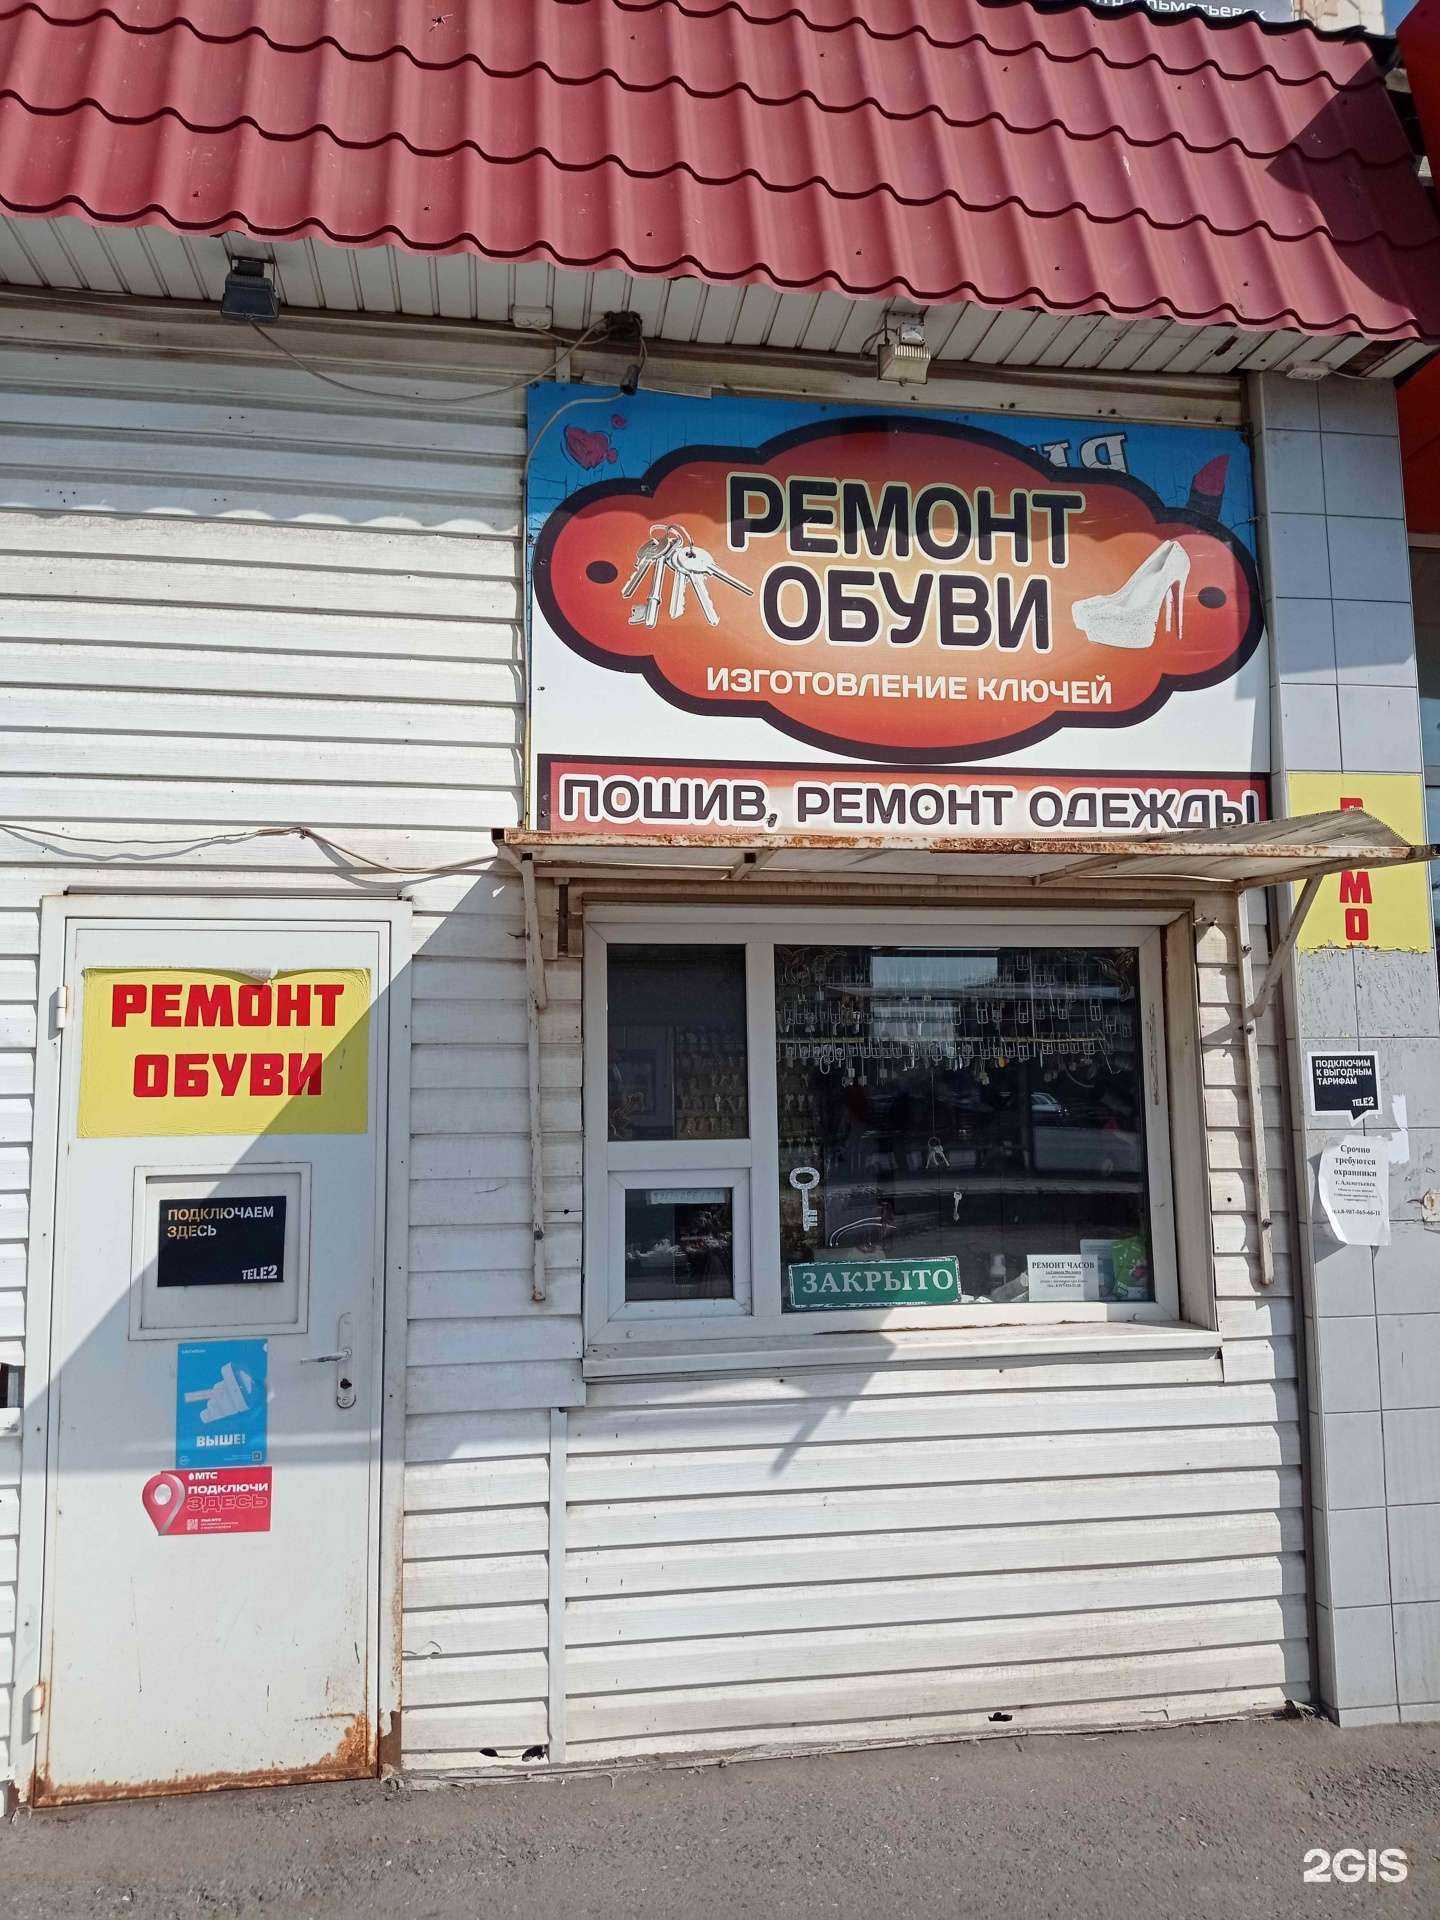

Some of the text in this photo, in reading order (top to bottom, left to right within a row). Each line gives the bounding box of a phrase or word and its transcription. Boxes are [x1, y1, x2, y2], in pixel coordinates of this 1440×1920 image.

[727, 473, 1085, 567] РЕМОНТ
[761, 562, 1053, 653] ОБУВИ
[706, 666, 1113, 705] ИЗГОТОВЛЕНИЕ КЛЮЧЕЙ
[562, 776, 1257, 829] ПОШИВ, РЕМОНТ ОДЕЖДЫ
[111, 983, 345, 1028] РЕМОНТ
[1315, 1059, 1371, 1069] ПОДКЛЮЧИМ
[132, 1052, 323, 1098] ОБУВИ
[1316, 1069, 1373, 1078] К ВЫГОДНЫМ
[1317, 1077, 1358, 1086] ТАРИФАМ
[1351, 1096, 1375, 1107] TELE2
[167, 1206, 275, 1222] ПОДКЛЮЧАЕМ
[167, 1225, 217, 1239] ЗДЕСЬ
[241, 1264, 278, 1280] TELE2
[1032, 1261, 1095, 1269] РЕМОНТ ЧАСОВ
[802, 1268, 954, 1295] ЗАКРЫТО
[195, 1433, 246, 1448] ВЫШЕ!
[195, 1471, 218, 1481] МТС
[187, 1482, 269, 1495] ПОДКЛЮЧИ
[186, 1494, 268, 1513] ЗДЕСЬ
